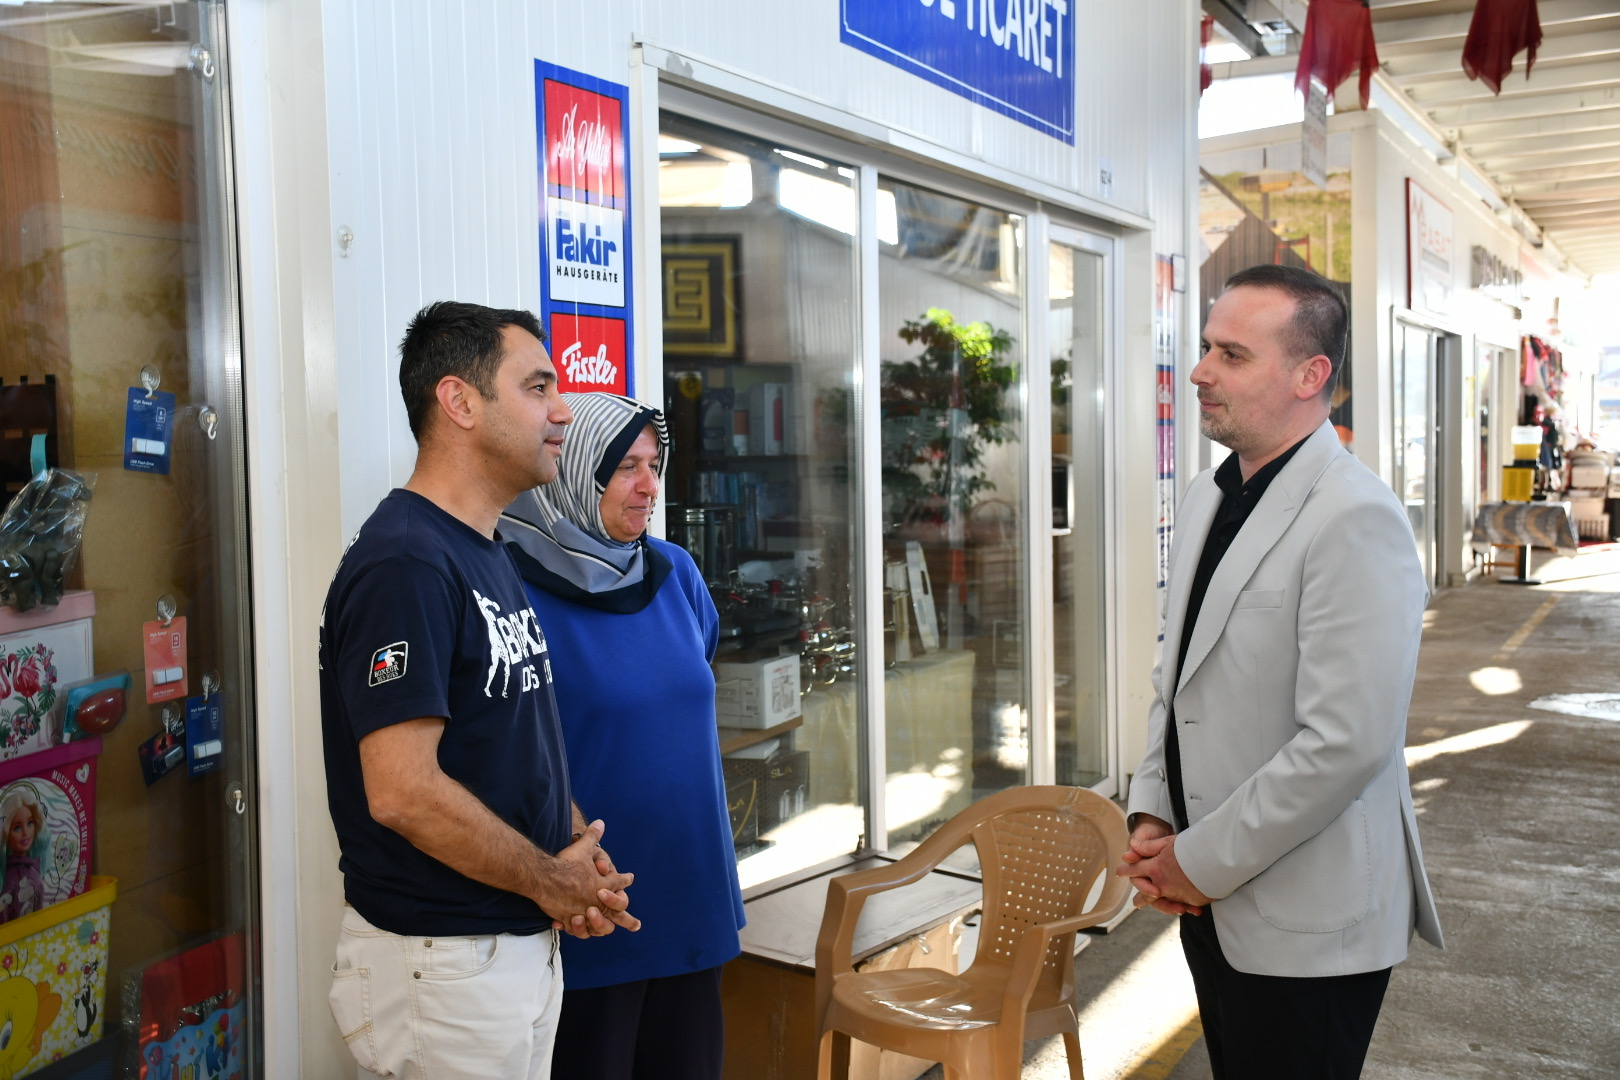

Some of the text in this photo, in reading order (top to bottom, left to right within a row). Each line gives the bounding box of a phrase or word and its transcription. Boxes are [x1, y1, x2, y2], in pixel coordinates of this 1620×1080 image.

[555, 217, 617, 268] Fakir
[556, 265, 619, 284] HAUSGERÄTE
[561, 340, 618, 386] Fissler
[374, 664, 400, 678] BOXEUR
[51, 770, 70, 789] MUSIC
[68, 784, 84, 811] MAKES
[79, 810, 87, 825] ME
[80, 825, 88, 852] SMILE
